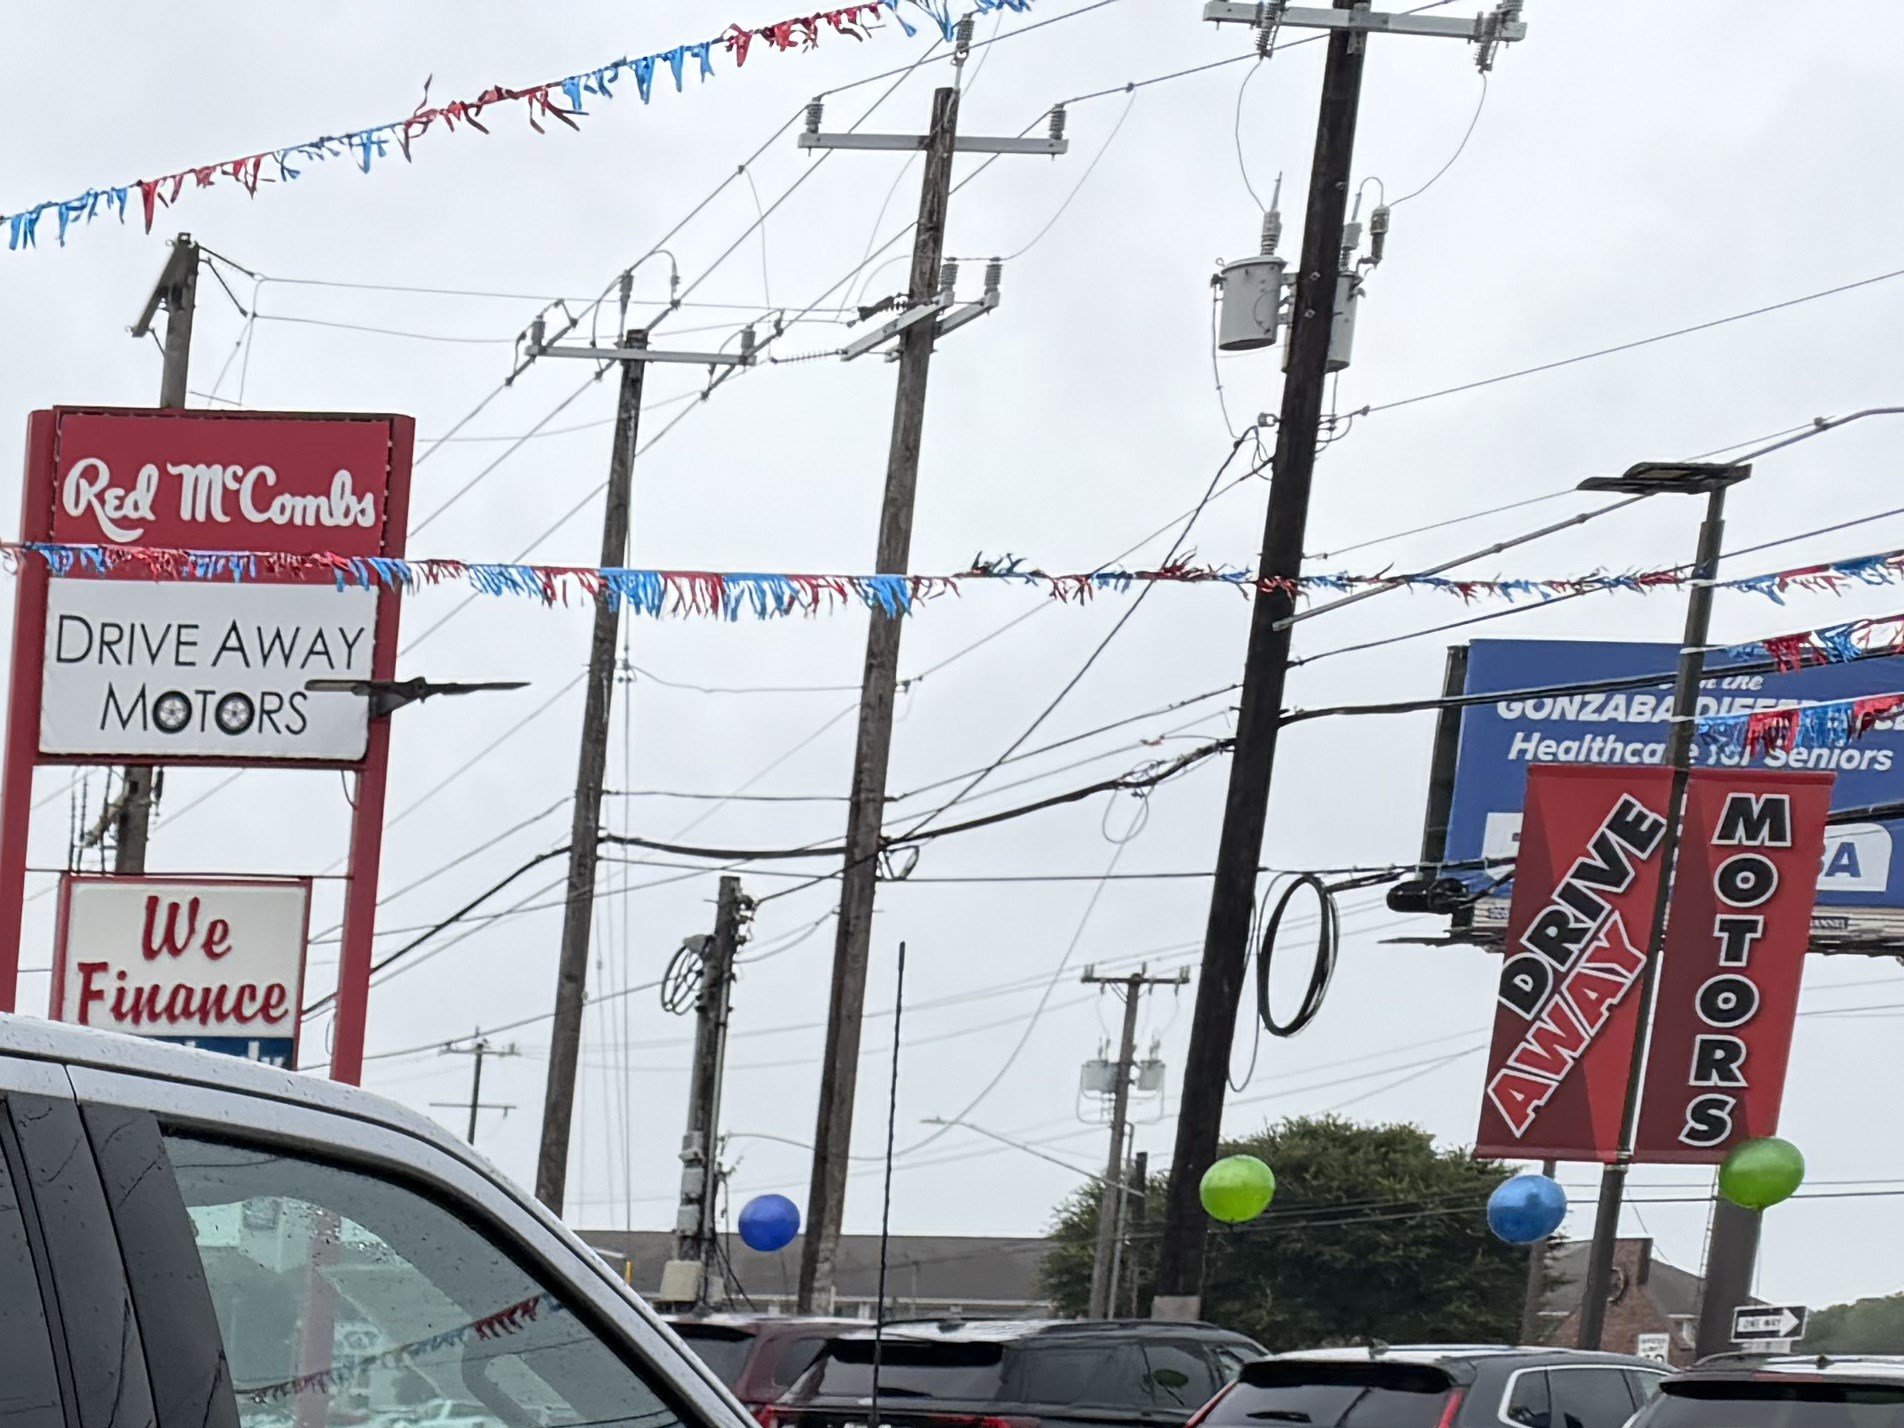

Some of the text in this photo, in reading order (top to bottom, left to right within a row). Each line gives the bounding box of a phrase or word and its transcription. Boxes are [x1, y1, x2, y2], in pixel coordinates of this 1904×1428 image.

[61, 457, 376, 542] Red McCombs
[55, 614, 366, 671] DRIVE AWAY
[1497, 694, 1676, 724] GONZABA
[1507, 731, 1700, 766] Healthcae
[140, 895, 233, 961] We
[1498, 793, 1667, 1020] DRIVE
[77, 961, 290, 1027] Finance
[1679, 793, 1792, 1147] MOTORS
[1487, 911, 1647, 1138] AWAY
